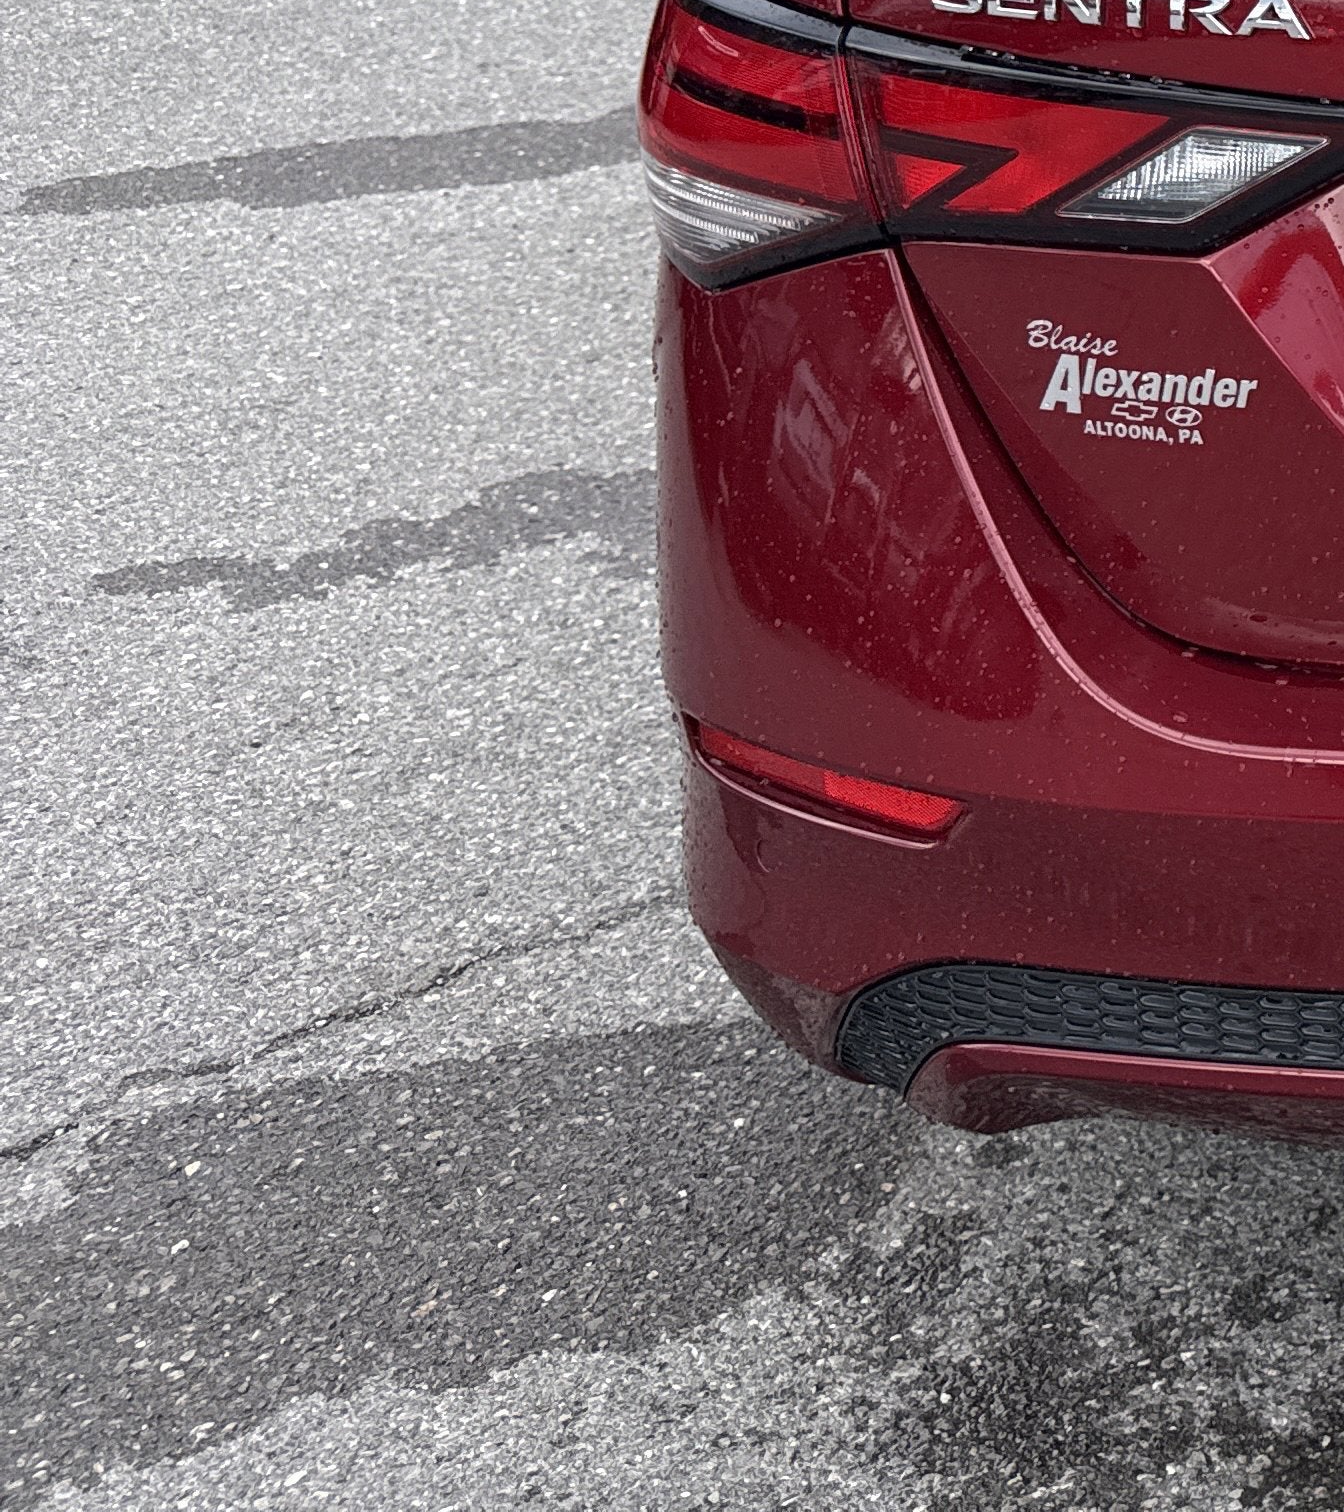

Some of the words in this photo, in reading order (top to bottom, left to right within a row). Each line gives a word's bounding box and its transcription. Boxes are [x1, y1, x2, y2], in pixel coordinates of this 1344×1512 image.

[1026, 319, 1119, 356] Blaise
[1039, 353, 1258, 414] Alexander
[1083, 420, 1174, 446] ALTOONA,
[1178, 429, 1204, 445] PA
